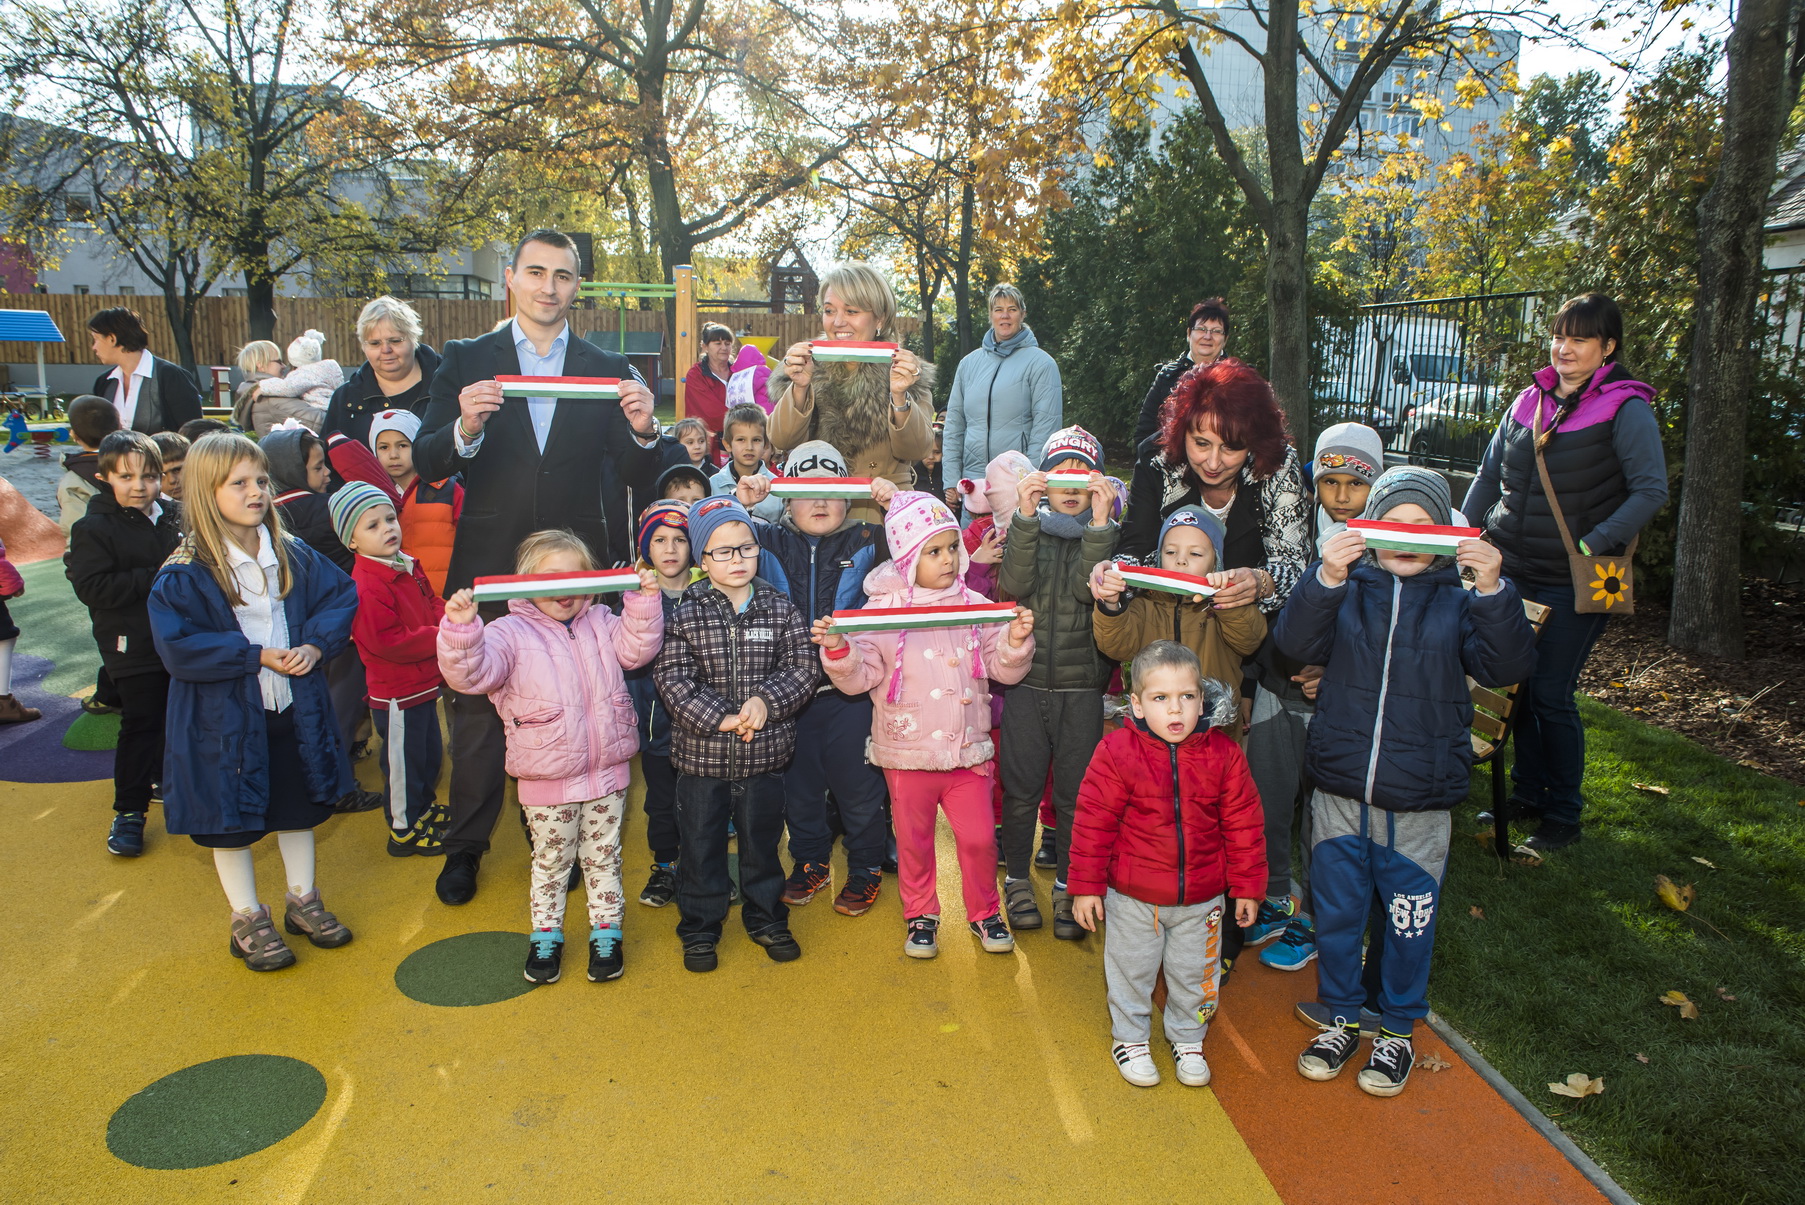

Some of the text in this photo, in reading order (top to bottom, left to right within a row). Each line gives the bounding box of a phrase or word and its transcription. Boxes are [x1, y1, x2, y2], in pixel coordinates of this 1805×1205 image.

[1047, 437, 1098, 457] ANGRY
[1407, 891, 1433, 901] ANGELES
[1388, 903, 1434, 920] NEW YORK
